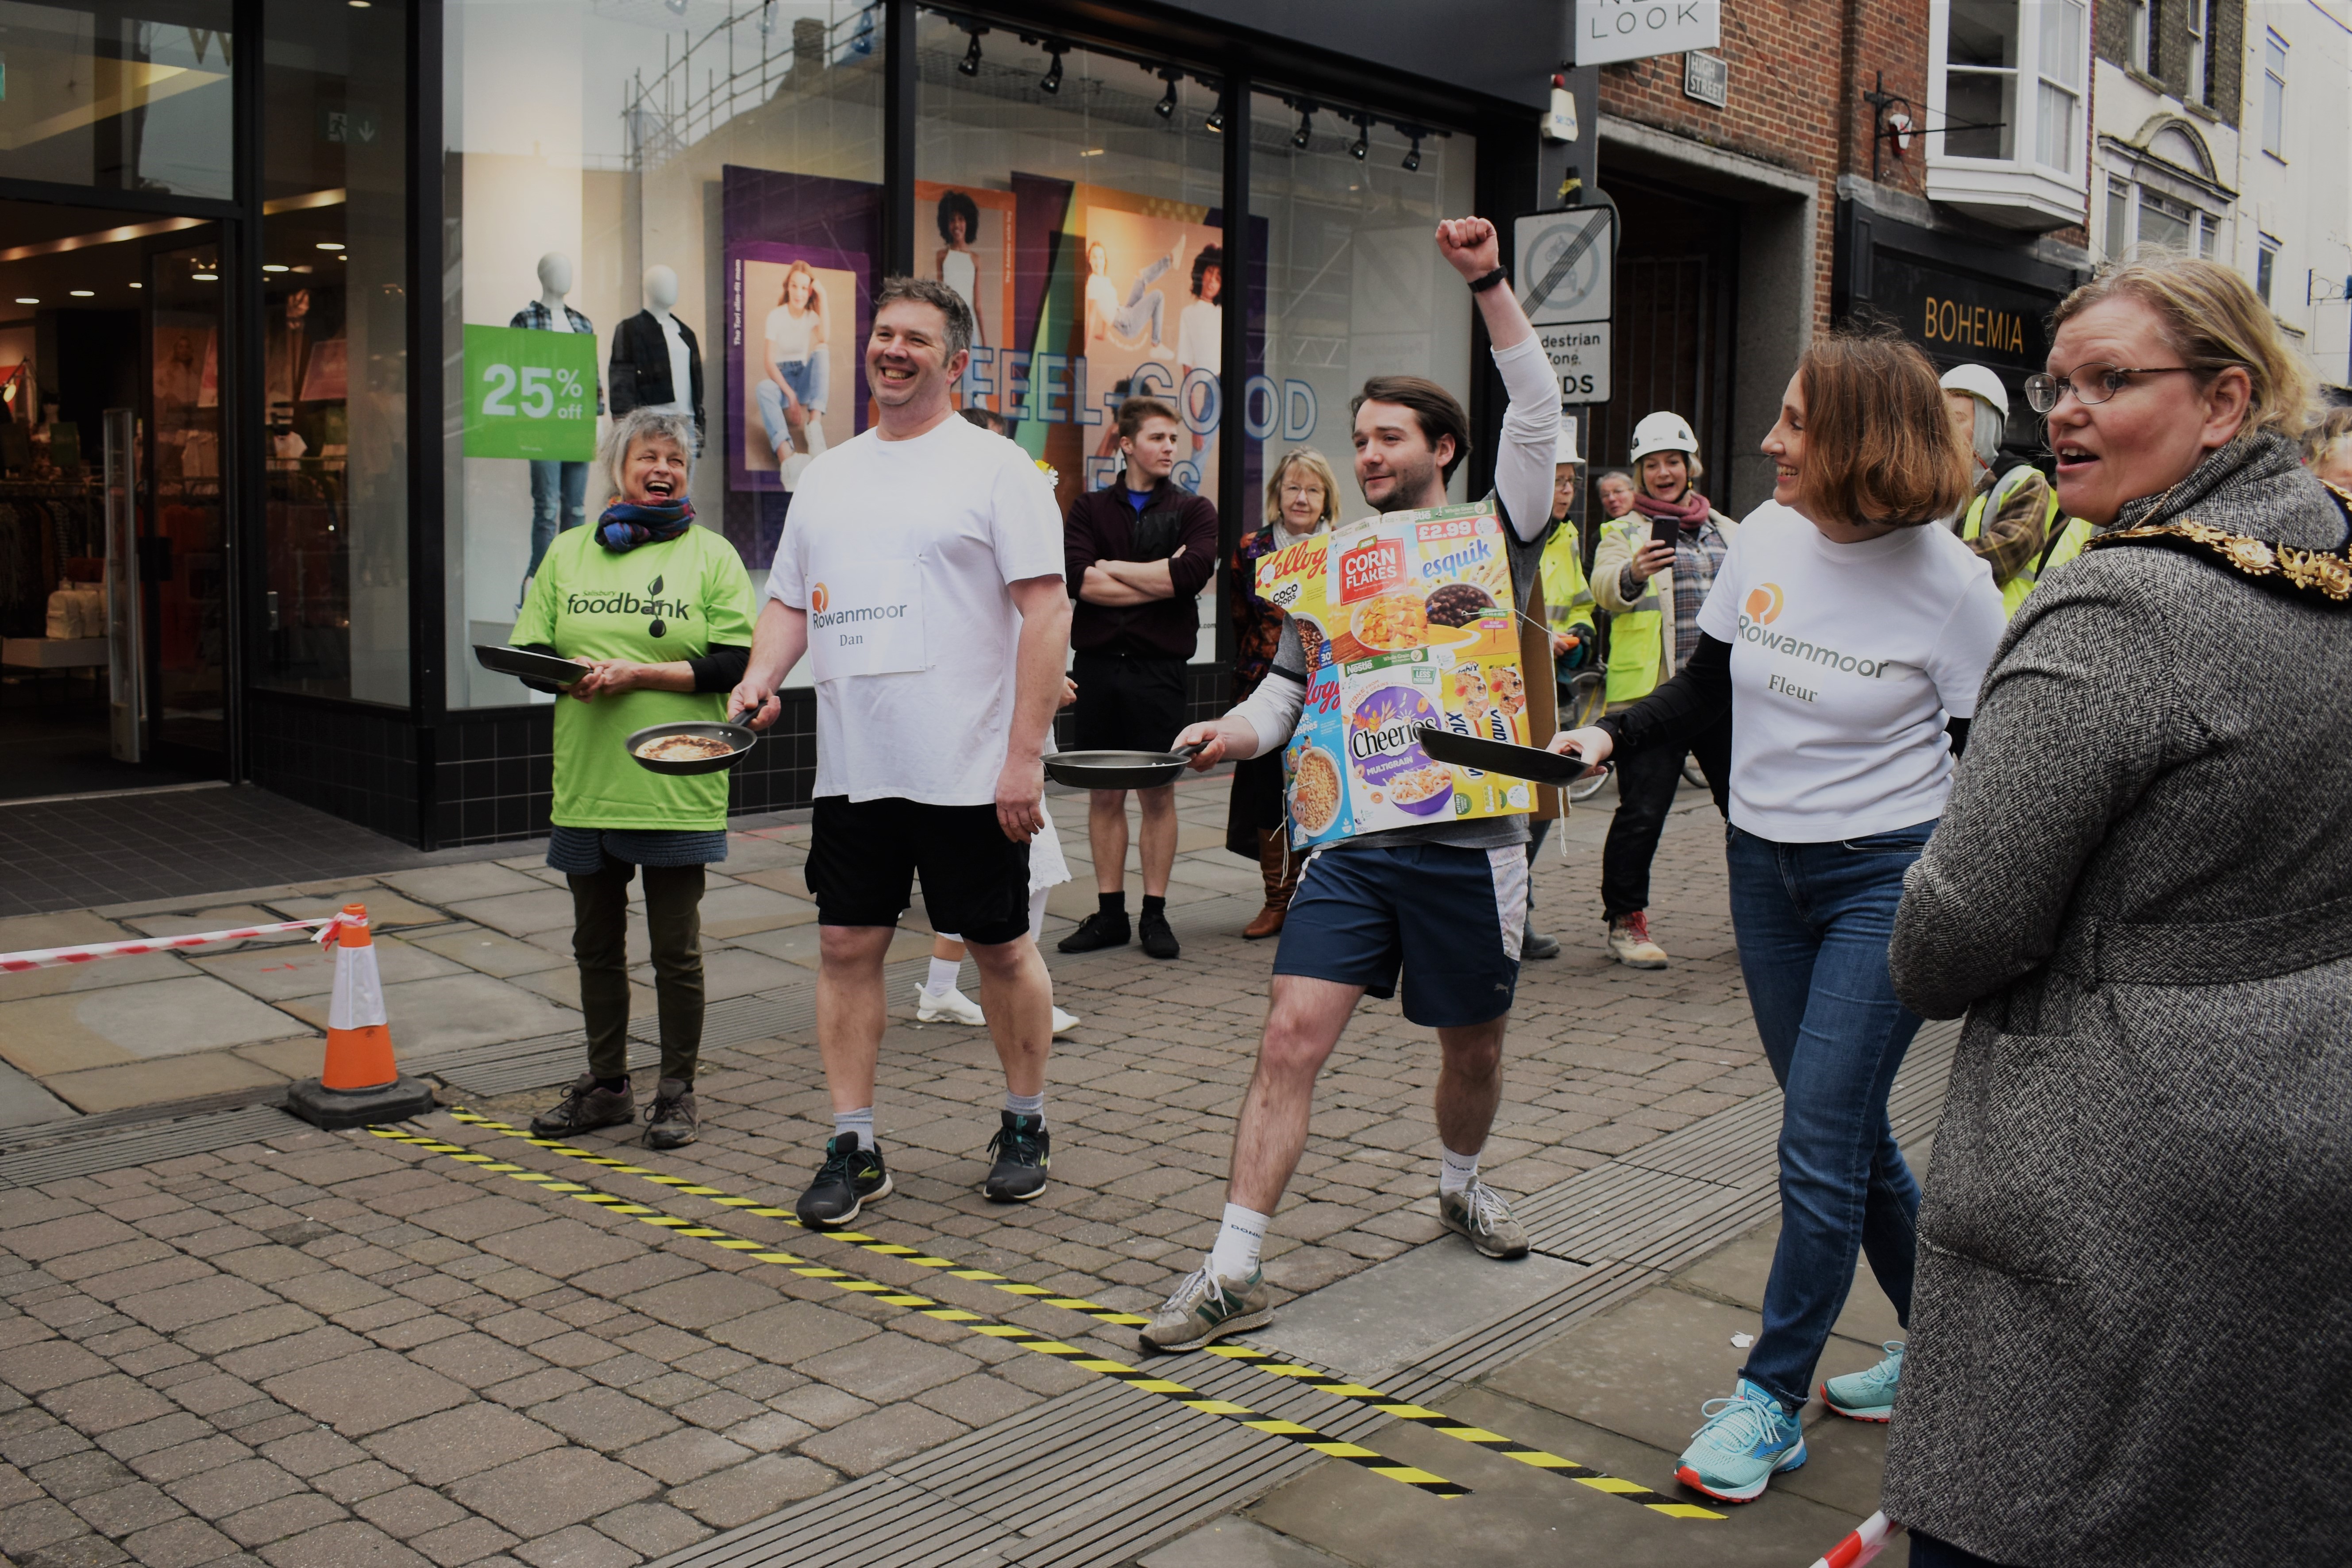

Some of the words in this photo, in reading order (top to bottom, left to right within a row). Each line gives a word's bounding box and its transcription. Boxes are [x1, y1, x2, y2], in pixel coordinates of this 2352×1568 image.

[1592, 1, 1698, 39] LOOK
[1691, 55, 1716, 78] HIGH
[1690, 75, 1723, 100] STREET
[1925, 297, 2024, 354] BOHEMIA
[1542, 332, 1600, 348] destrian
[1563, 374, 1594, 394] DS
[558, 403, 583, 420] off
[1419, 520, 1472, 540] £2.99
[1345, 547, 1396, 575] CORN
[1423, 539, 1492, 578] esquik
[1346, 565, 1397, 589] FLAKES
[567, 593, 690, 620] foodbank
[813, 605, 907, 630] Rowanmoor
[840, 634, 864, 647] Dan
[1739, 615, 1889, 678] Rowanmoor
[1321, 651, 1332, 663] 30
[1768, 674, 1818, 702] Fleur
[1366, 755, 1414, 776] MULTIGRAIN
